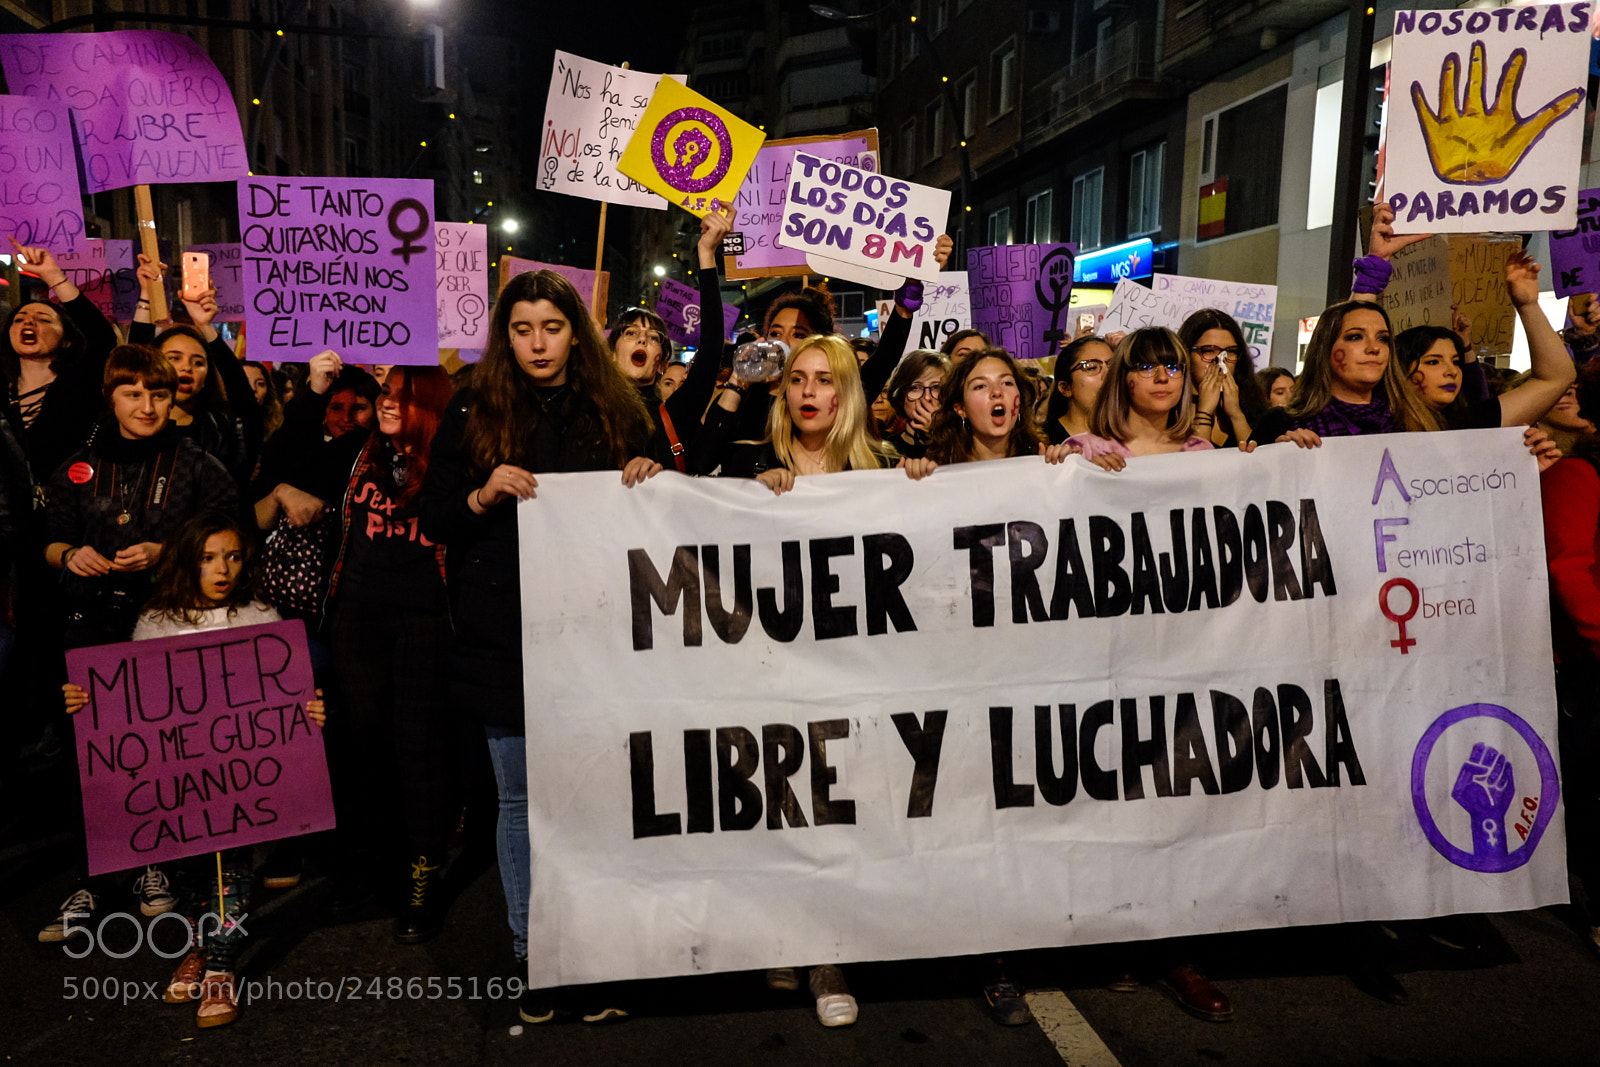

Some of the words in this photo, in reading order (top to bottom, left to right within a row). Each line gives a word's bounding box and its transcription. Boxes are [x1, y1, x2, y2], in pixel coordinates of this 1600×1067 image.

[1395, 2, 1591, 40] NOSOTRAS
[12, 44, 65, 75] DE
[72, 38, 185, 79] CAMINO
[127, 75, 226, 123] QUIERO
[600, 71, 623, 107] ha
[0, 105, 57, 133] LGO
[113, 112, 207, 142] LIBRE
[599, 106, 638, 140] femi
[0, 145, 18, 174] S
[24, 142, 63, 174] UN
[118, 140, 243, 178] VALIENTE
[608, 138, 623, 164] h
[567, 163, 584, 183] de
[593, 162, 612, 188] la
[772, 160, 792, 183] LA
[796, 154, 911, 209] TODOS
[247, 183, 291, 219] DE
[300, 186, 384, 219] TANTO
[738, 189, 761, 208] NI
[768, 189, 787, 206] LA
[790, 181, 849, 215] LOS
[853, 202, 935, 243] DÍAS
[1389, 185, 1567, 223] PARAMOS
[738, 211, 783, 227] SOMOS
[243, 223, 379, 255] QUITARNOS
[435, 228, 450, 248] S
[455, 230, 469, 246] Y
[743, 234, 769, 253] DE
[785, 212, 853, 250] SON
[862, 233, 924, 268] 8M
[245, 254, 358, 288] TAMBIÉN
[365, 266, 410, 292] NOS
[456, 250, 482, 273] QUE
[967, 244, 1041, 286] PELEA
[1110, 261, 1131, 279] MGS
[1560, 266, 1585, 290] DE
[60, 267, 136, 295] TODAS
[446, 275, 471, 292] SER
[1116, 281, 1141, 302] NO
[1141, 292, 1163, 308] ES
[1158, 276, 1179, 292] DE
[1220, 285, 1231, 295] A
[1235, 286, 1267, 299] CASA
[1450, 277, 1513, 307] ODEMO
[253, 288, 387, 316] QUITARON
[918, 302, 939, 318] DE
[944, 302, 967, 316] LAS
[997, 303, 1033, 322] UNA
[269, 316, 312, 347] EL
[323, 319, 411, 348] MIEDO
[152, 476, 167, 504] Canon
[1371, 447, 1517, 505] Asociación
[353, 481, 398, 516] Sex
[1373, 517, 1487, 573] Feminista
[627, 532, 919, 652] MUJER
[953, 498, 1337, 628] TRABAJADORA
[1378, 577, 1477, 655] Obrera
[88, 633, 308, 730] MUJER
[87, 732, 149, 780] NO
[159, 721, 205, 762] ME
[210, 702, 312, 754] GUSTA
[629, 718, 857, 839] LIBRE
[889, 710, 949, 819] Y
[988, 678, 1368, 810] LUCHADORA
[125, 756, 283, 816] CUANDO
[129, 797, 279, 853] CALLAS
[1513, 796, 1539, 842] A.F.O.
